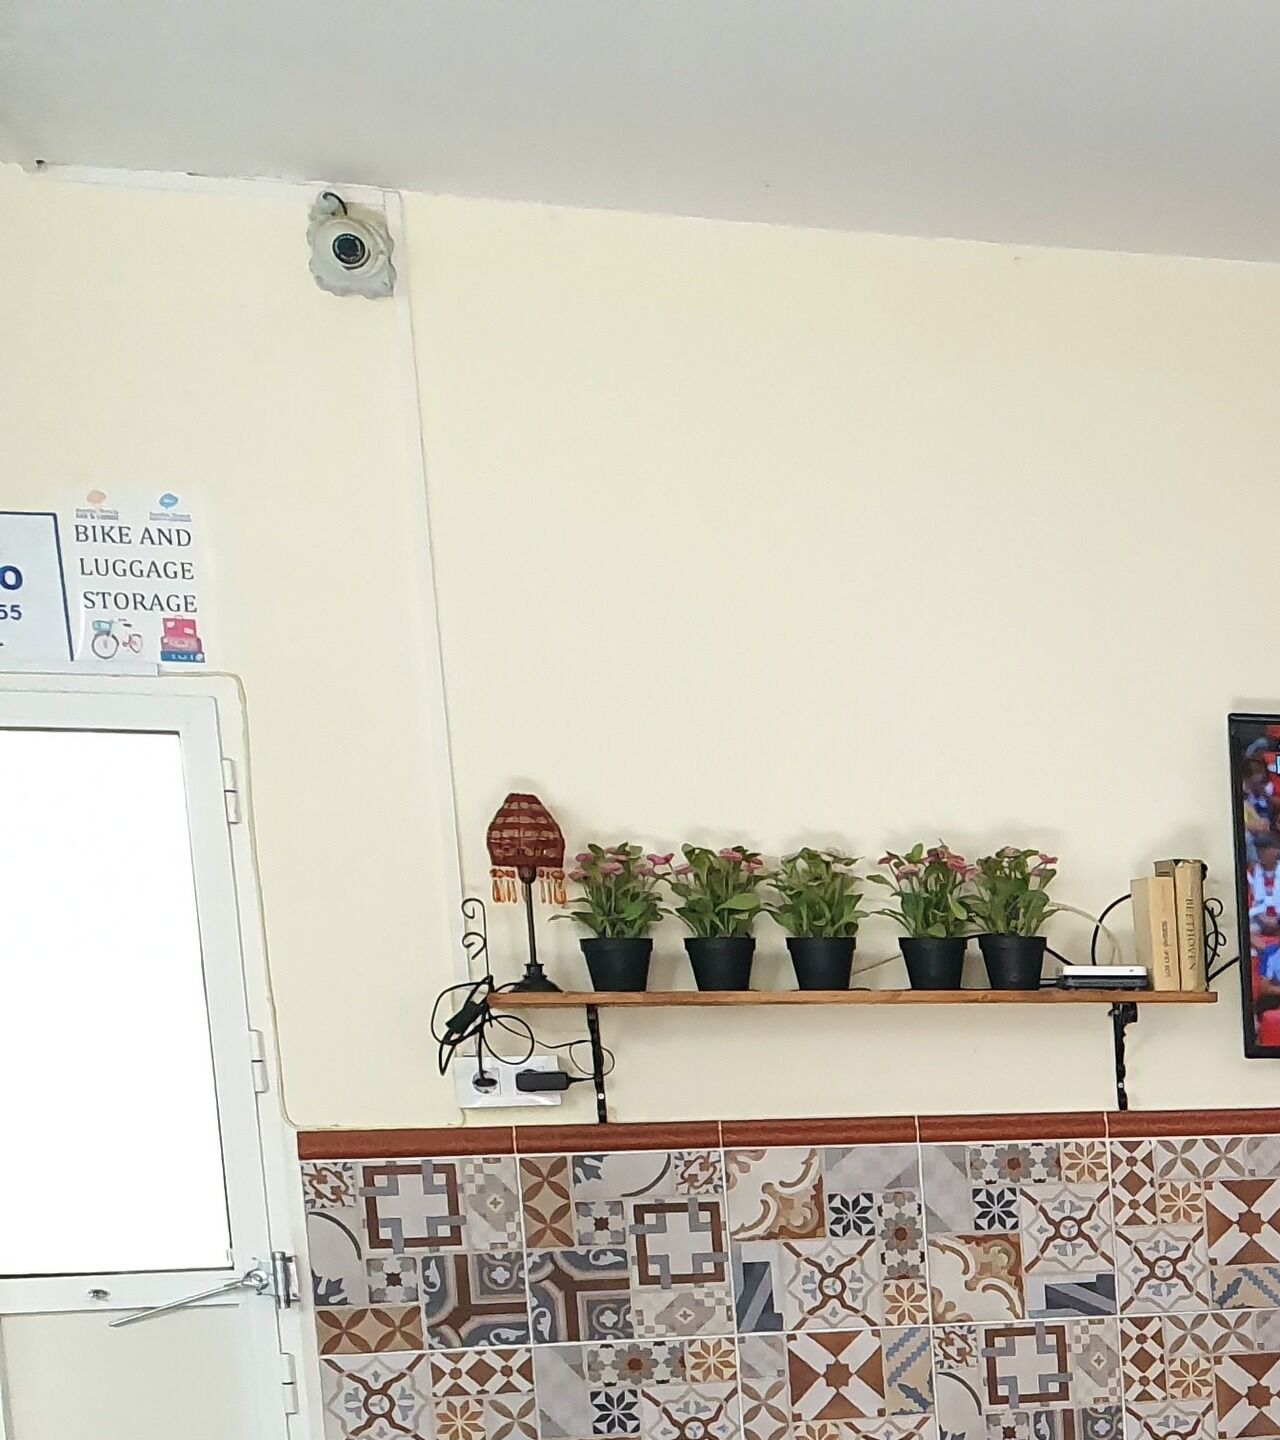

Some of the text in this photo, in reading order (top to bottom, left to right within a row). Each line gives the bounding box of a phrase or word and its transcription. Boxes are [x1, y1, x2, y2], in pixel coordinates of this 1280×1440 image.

[74, 524, 192, 547] BIKE AND
[79, 557, 195, 580] LUGGAGE
[83, 590, 198, 613] STORAGE
